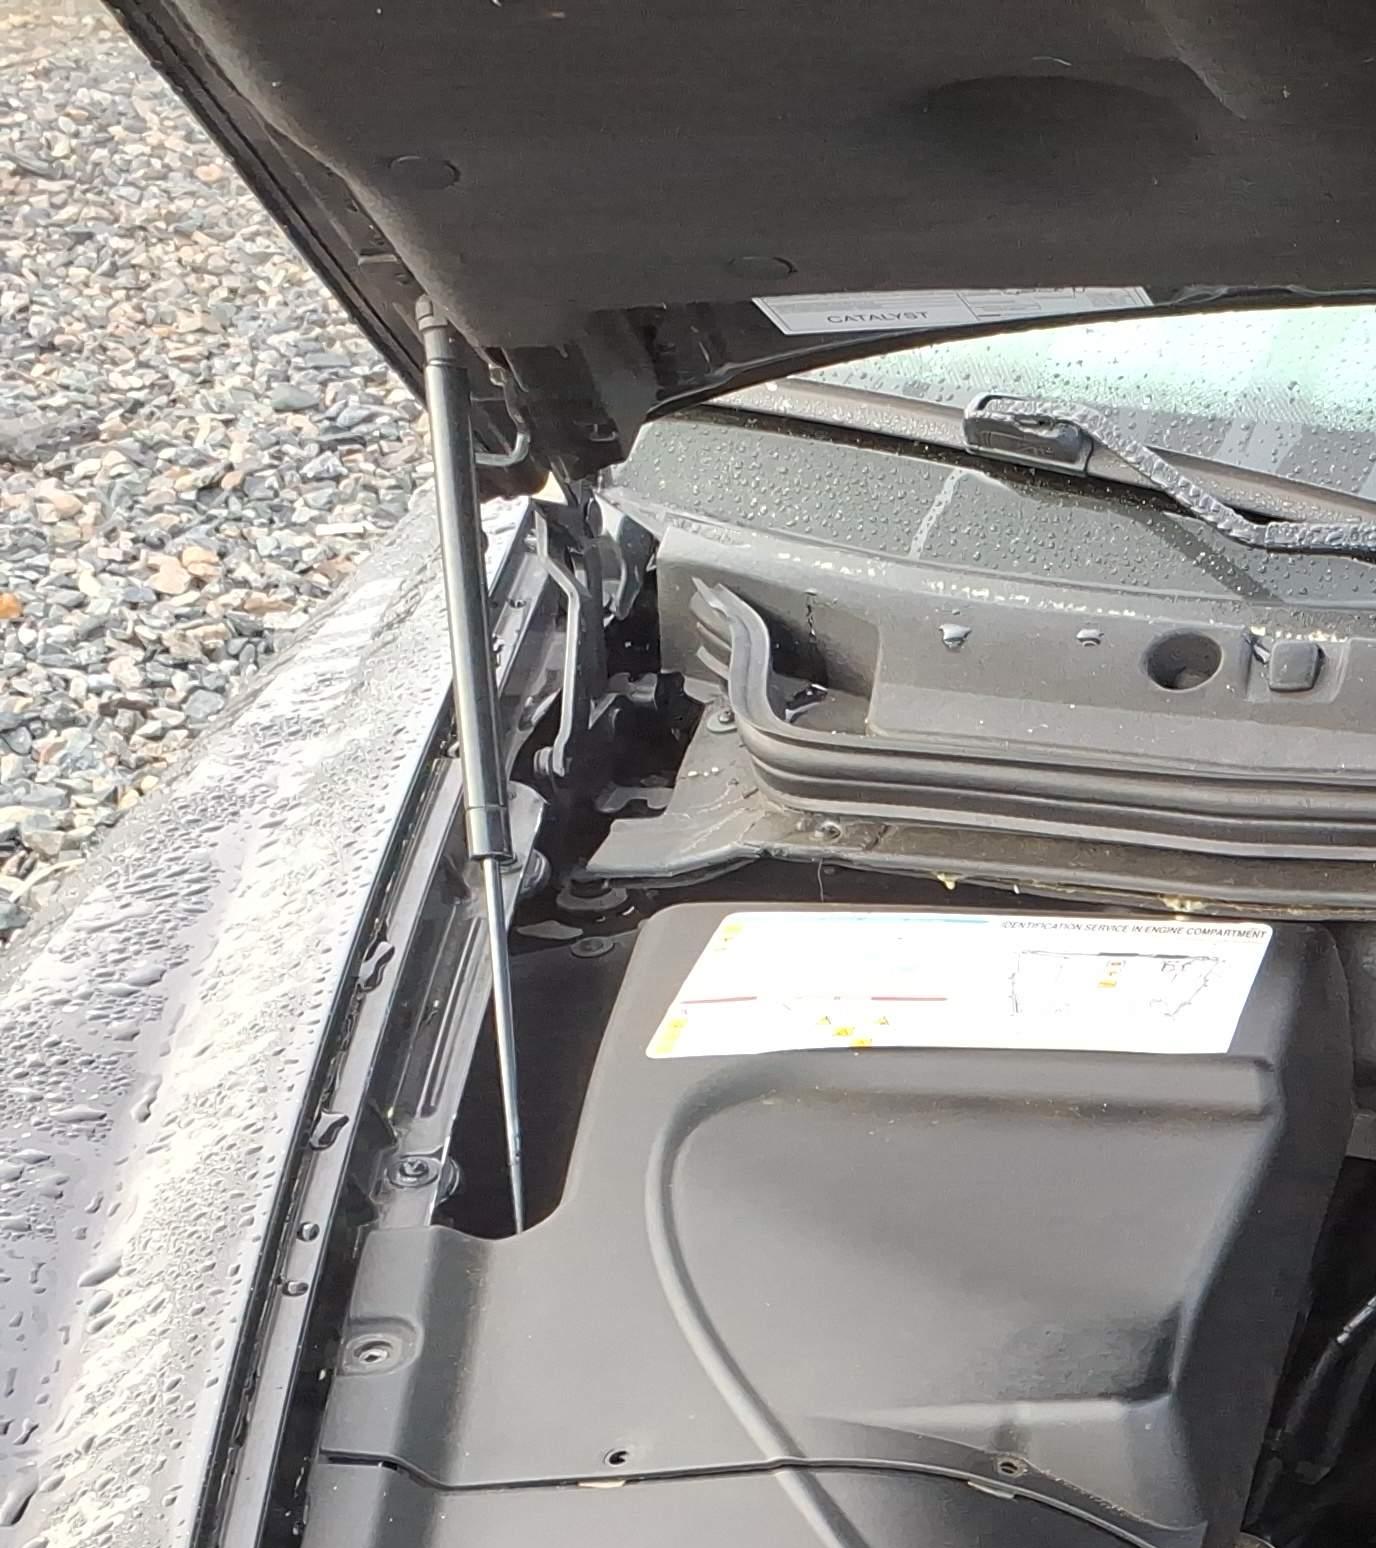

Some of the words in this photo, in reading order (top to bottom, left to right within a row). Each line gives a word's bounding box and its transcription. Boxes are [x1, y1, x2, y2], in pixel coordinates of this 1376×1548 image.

[826, 311, 929, 324] CATALYST
[1001, 920, 1082, 931] IDENTIFICATION
[1085, 922, 1128, 933] SERVICE
[1131, 924, 1143, 933] IN
[1144, 925, 1184, 935] ENGINE
[1186, 927, 1268, 939] COMPARTMENT
